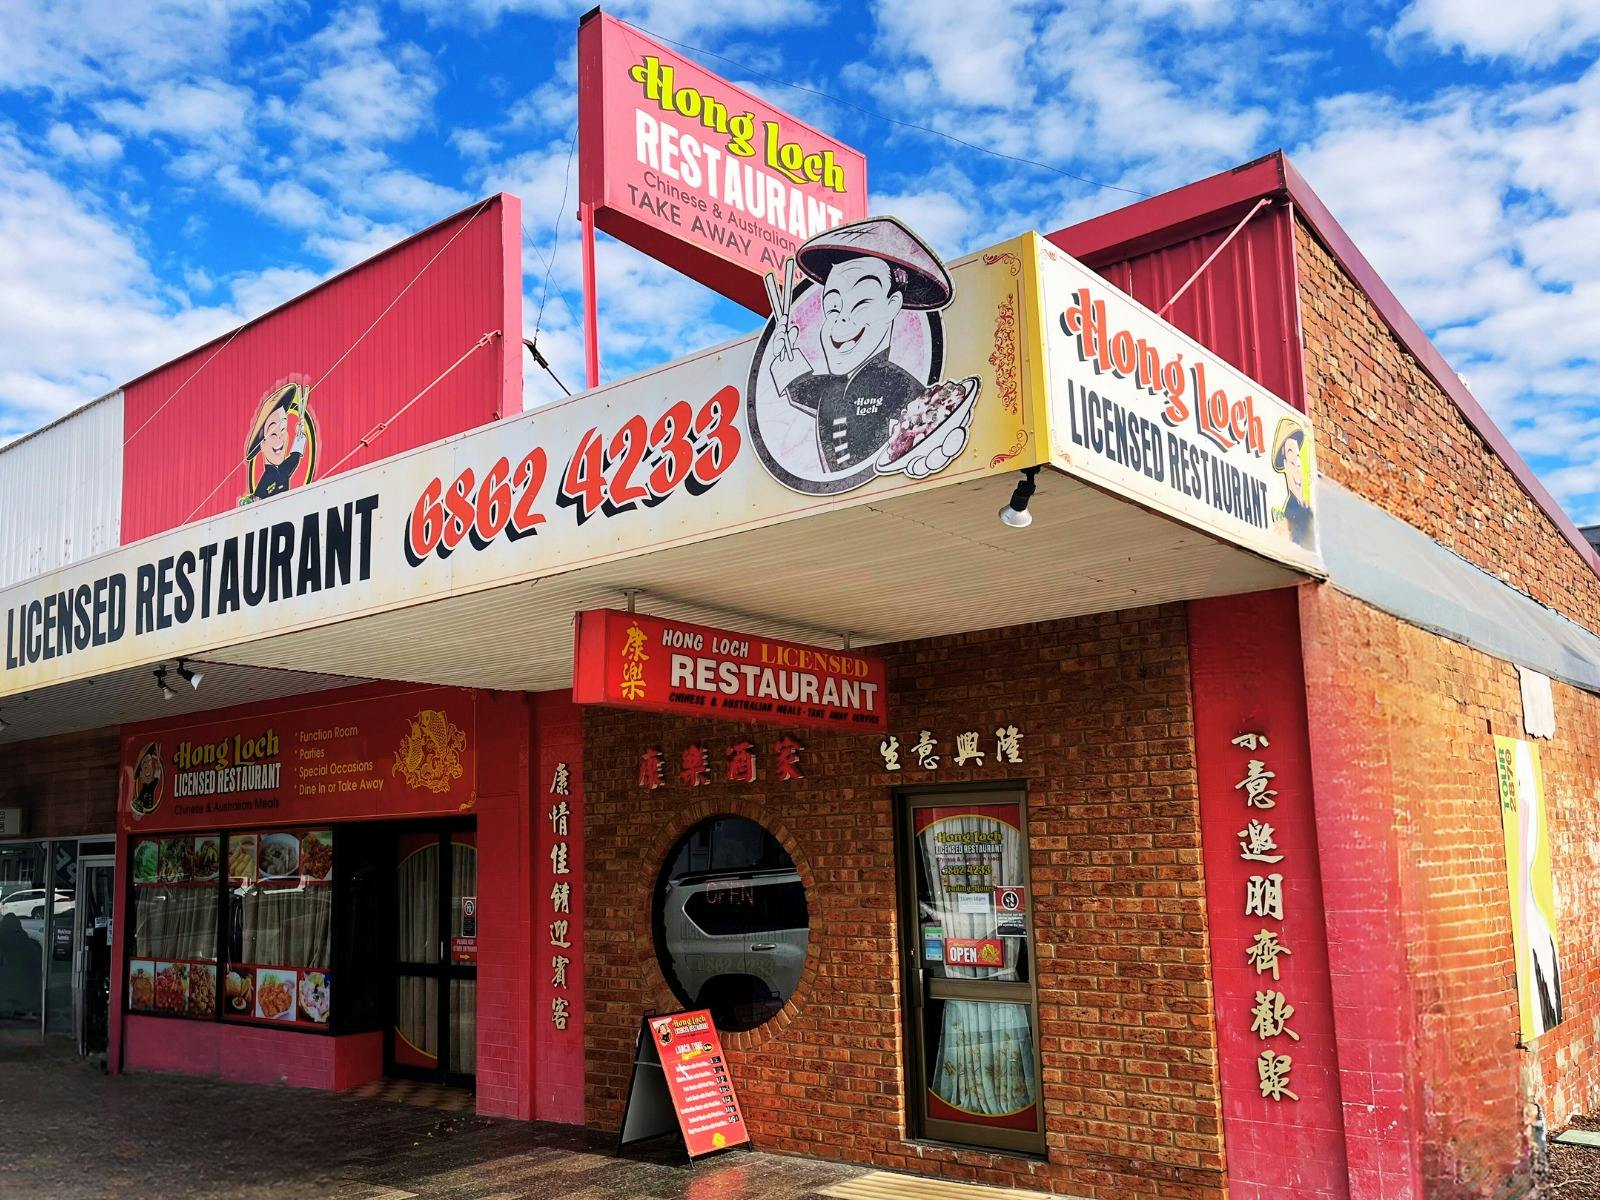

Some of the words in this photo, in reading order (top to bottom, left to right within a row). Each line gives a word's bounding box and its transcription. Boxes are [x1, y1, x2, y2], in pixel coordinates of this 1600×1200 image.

[628, 55, 756, 157] Hong
[763, 120, 846, 192] Loch
[636, 108, 843, 240] RESTAURANT
[628, 184, 681, 226] TAKE
[691, 216, 751, 256] AWAY
[644, 171, 707, 212] Chinese
[713, 203, 722, 220] &
[728, 212, 796, 252] Australian
[1060, 288, 1189, 427] Hong
[1191, 363, 1265, 457] Loch
[854, 396, 883, 406] Hong
[856, 405, 878, 415] Loch
[1068, 378, 1164, 483] LICENSED
[1168, 432, 1268, 529] RESTAURANT
[404, 447, 547, 567] 6862
[556, 385, 741, 526] 4233
[6, 573, 126, 670] LICENSED
[136, 494, 379, 635] RESTAURANT
[662, 629, 703, 650] HONG
[712, 636, 749, 658] LOCH
[760, 643, 868, 678] LICENSED
[671, 654, 878, 711] RESTAURANT
[669, 692, 705, 705] CHINESE
[710, 697, 717, 706] &
[722, 698, 772, 712] AUSTRALIAN
[808, 708, 825, 718] TAKE
[829, 711, 848, 720] AWAY
[853, 714, 879, 724] SERVICE
[174, 737, 229, 770] Hong
[234, 729, 279, 765] Loch
[300, 728, 332, 742] Function
[334, 726, 358, 738] Room
[880, 725, 1024, 770] 生意興隆
[299, 748, 325, 760] Parties
[299, 764, 328, 779] Special
[330, 760, 373, 774] Occasions
[174, 769, 216, 798] LICENSED
[218, 762, 281, 793] RESTAURANT
[299, 784, 316, 796] Dine
[318, 783, 326, 794] In
[328, 783, 336, 793] or
[337, 780, 357, 792] Take
[360, 778, 384, 791] Away
[935, 831, 971, 844] Hong
[973, 831, 1003, 844] Loch
[935, 845, 963, 854] LICENSED
[964, 844, 1002, 854] RESTAURANT
[966, 864, 992, 875] 4233
[950, 946, 977, 962] OPEN
[672, 1018, 692, 1028] Hong
[692, 1016, 706, 1026] Loch
